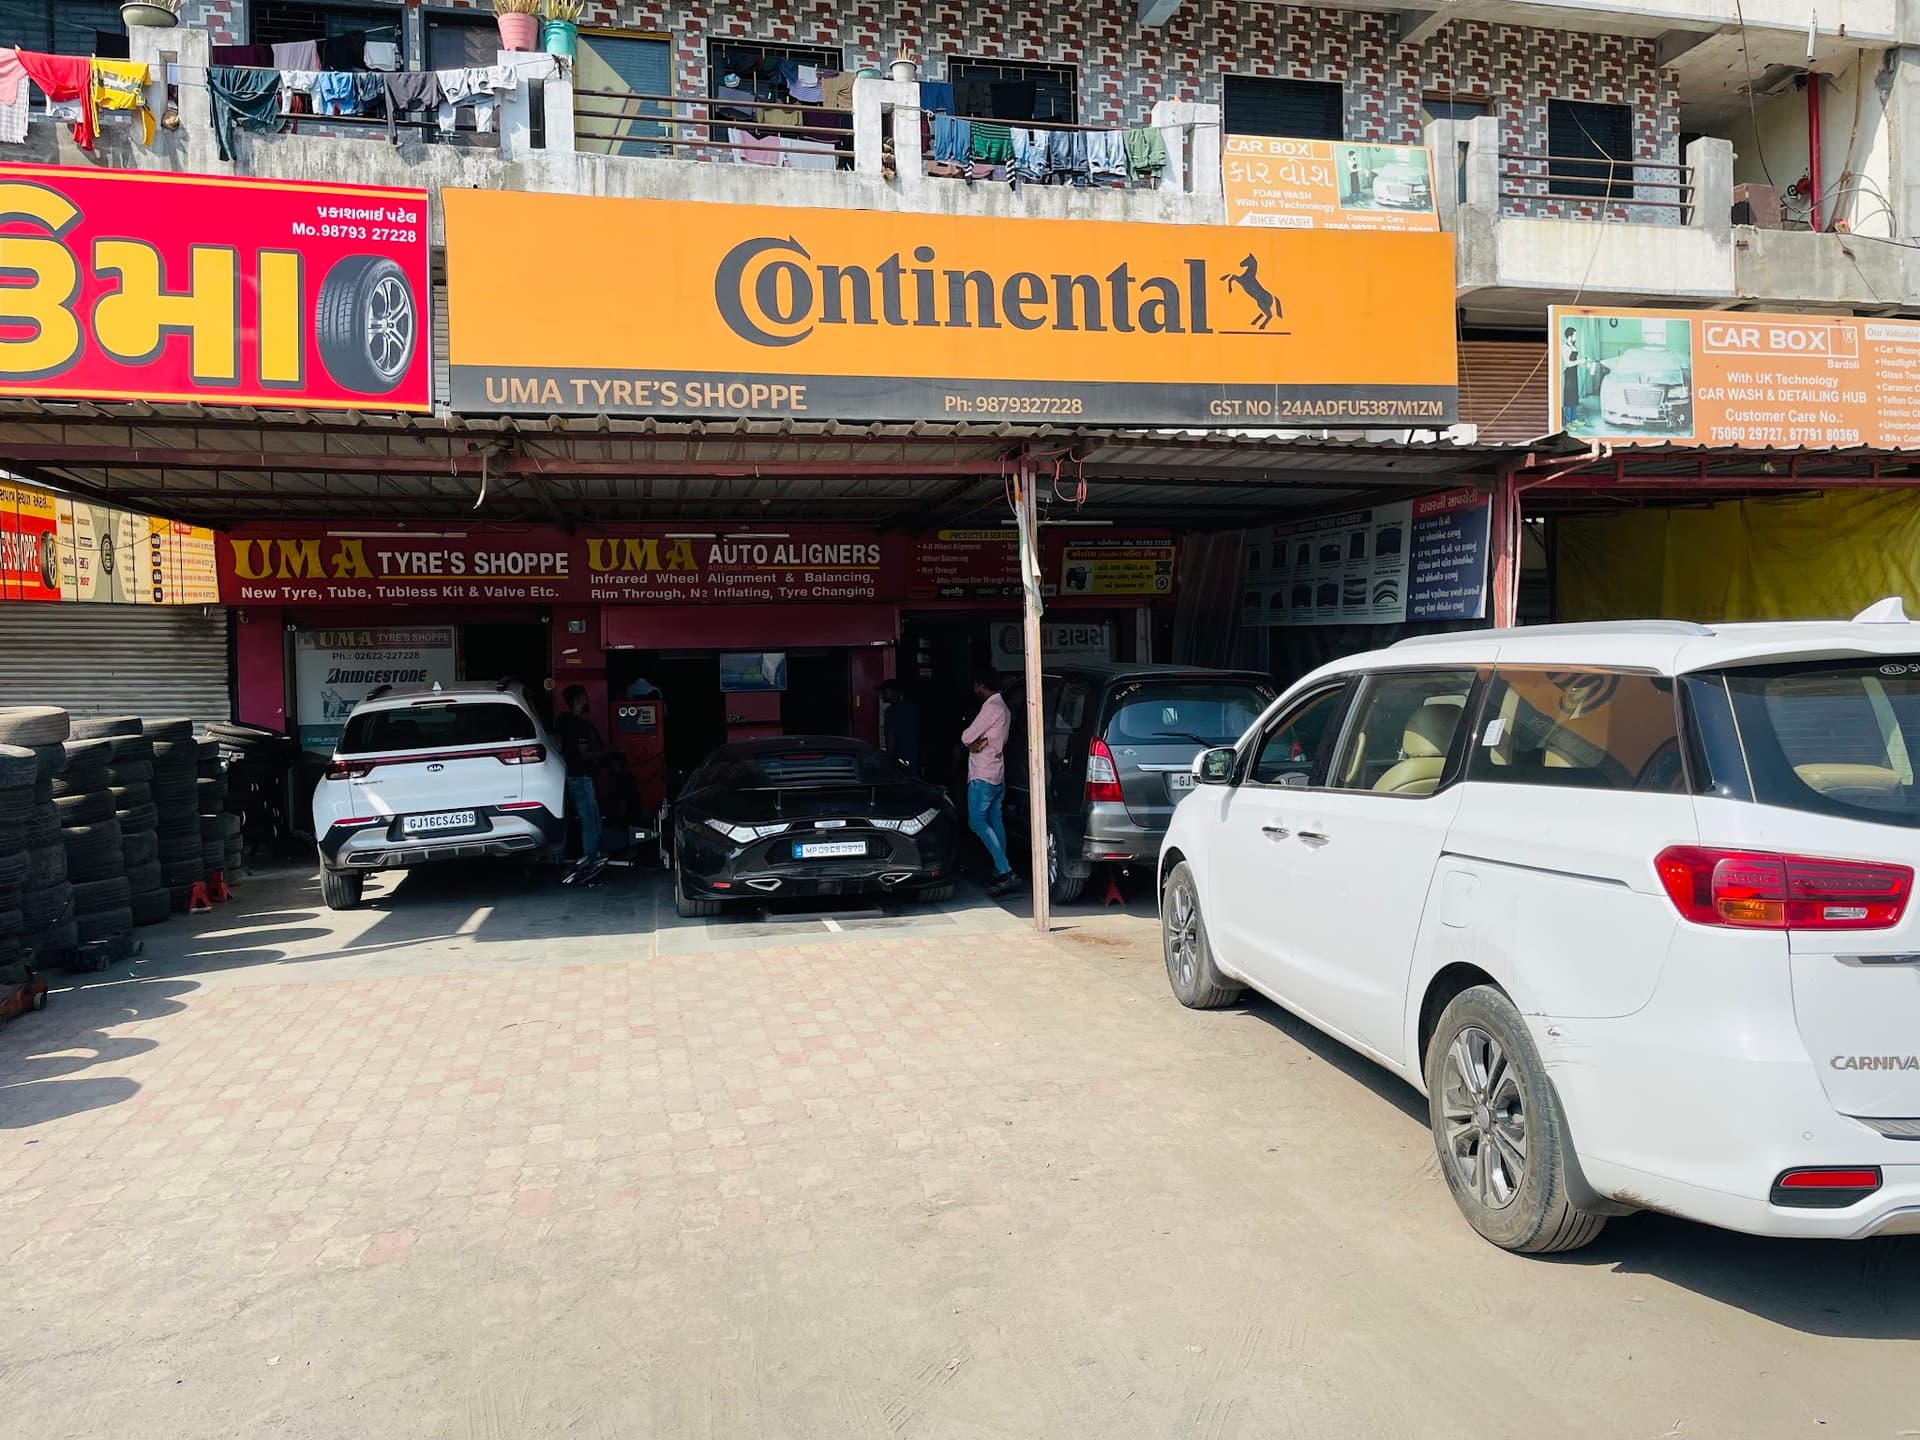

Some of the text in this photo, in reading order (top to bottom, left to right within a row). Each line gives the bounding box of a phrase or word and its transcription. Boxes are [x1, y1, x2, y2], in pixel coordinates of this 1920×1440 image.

[1226, 139, 1311, 156] CAR BOX
[1229, 160, 1272, 184] કાર
[1253, 189, 1312, 200] FOAM WASH
[1236, 198, 1336, 212] With UK Technology
[317, 206, 417, 224] પ્રકાશભાઈ પટેલ
[1250, 215, 1312, 227] BIKE WASH
[372, 228, 417, 242] 27228
[714, 235, 1213, 347] Continental
[1707, 327, 1760, 348] CAR
[1769, 330, 1826, 351] BOX
[1828, 359, 1860, 369] Bardoli
[1727, 372, 1839, 388] With UK Technology
[486, 377, 808, 411] UMA TYRE'S SHOPPE
[1698, 388, 1868, 404] CAR WASH & DETAILING HUB
[944, 396, 1083, 415] Ph: 9879327228
[1209, 399, 1242, 417] GST
[1246, 400, 1271, 417] NO
[1725, 409, 1784, 422] Customer
[1788, 411, 1816, 423] Care
[1710, 426, 1860, 442] 75060 29727, 87791 80369
[230, 539, 375, 580] UMA
[377, 551, 465, 574] TYRE'S
[474, 551, 569, 574] SHOPPE
[586, 538, 881, 572] UMA AUTO ALIGNERS
[591, 572, 875, 586] Infrared Wheel Alignment & Balancing,
[241, 586, 560, 601] New Tyre, Tube, Tubless Kit & Valve Etc.
[591, 588, 619, 600] Rim
[623, 588, 686, 600] Through,
[714, 587, 774, 600] Inflating,
[779, 587, 808, 599] Tyre
[812, 586, 875, 599] Changing
[320, 631, 450, 648] UMA TYRE'S SHOPPE
[355, 651, 420, 660] 02622-227228
[325, 668, 428, 684] BRIDGESTONE
[1881, 664, 1906, 674] KIA
